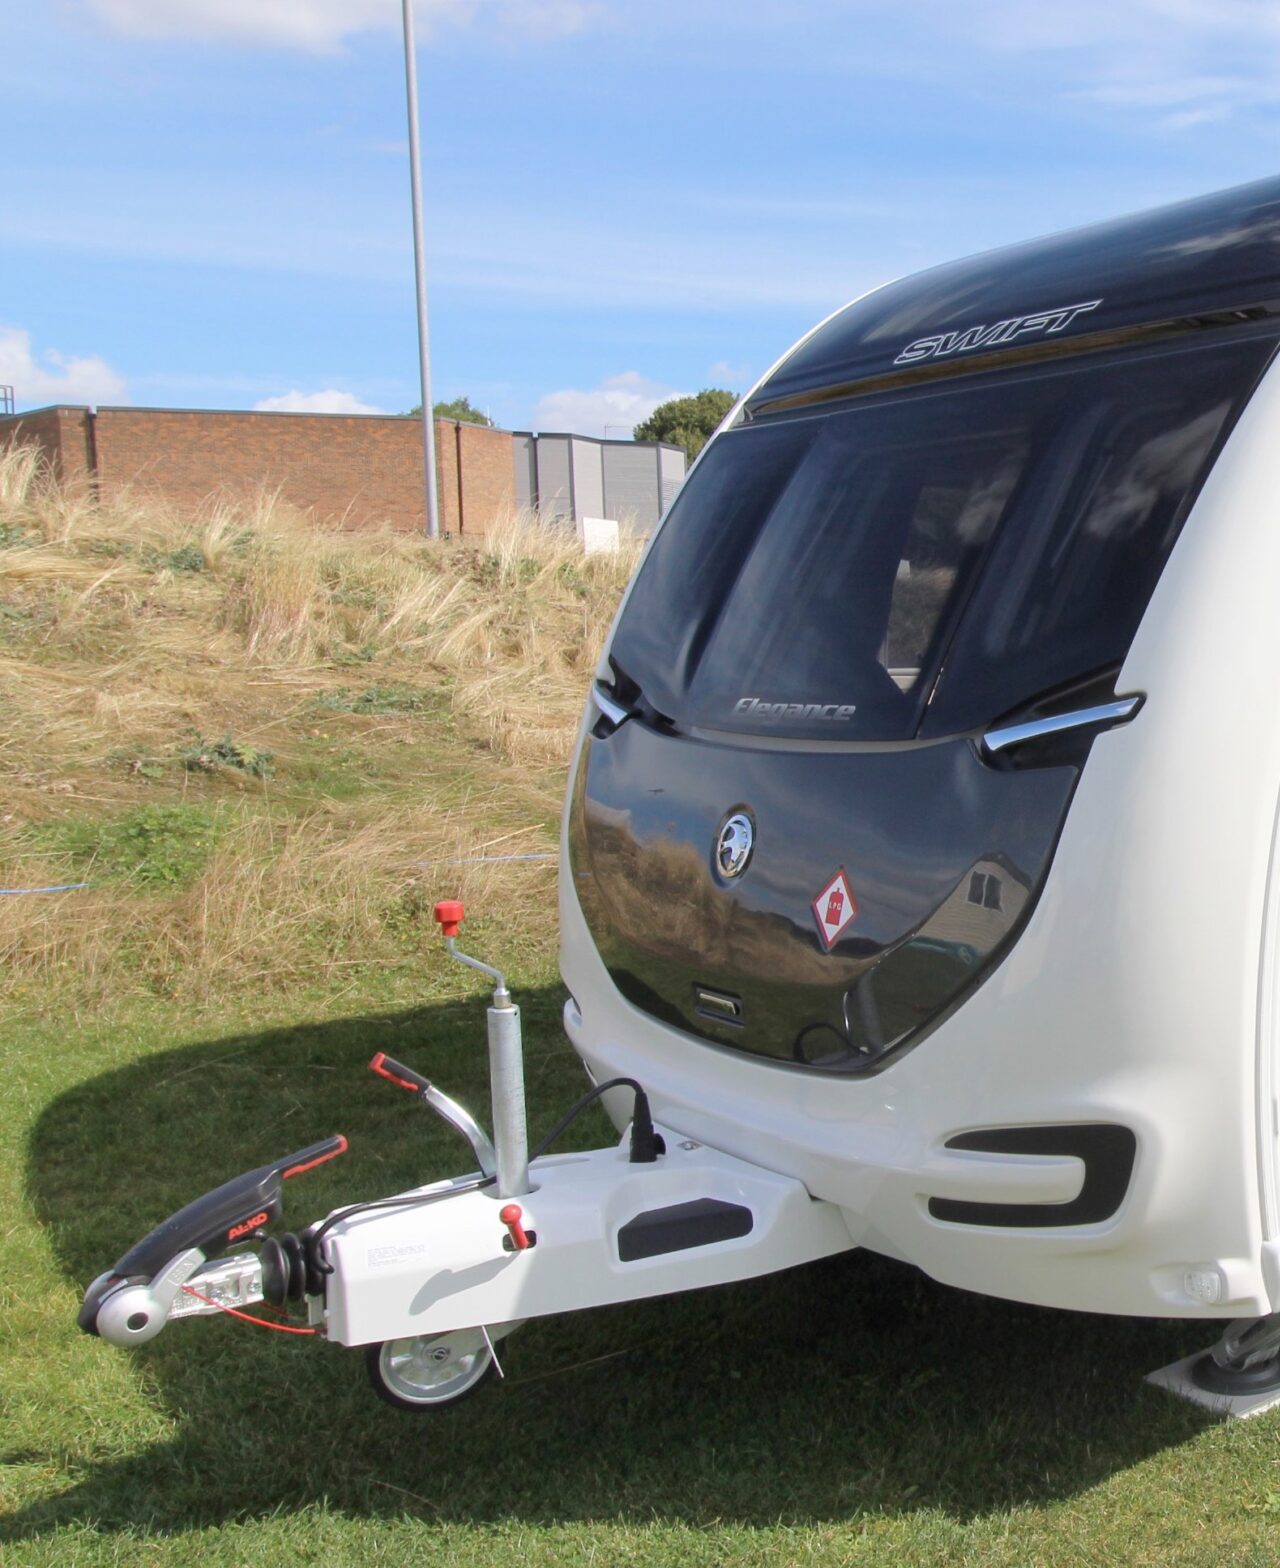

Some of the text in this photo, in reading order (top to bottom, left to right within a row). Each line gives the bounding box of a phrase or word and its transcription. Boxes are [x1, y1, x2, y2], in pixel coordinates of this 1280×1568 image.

[893, 299, 1104, 365] SWIFT
[733, 698, 857, 721] Elegance
[829, 901, 842, 911] LPG
